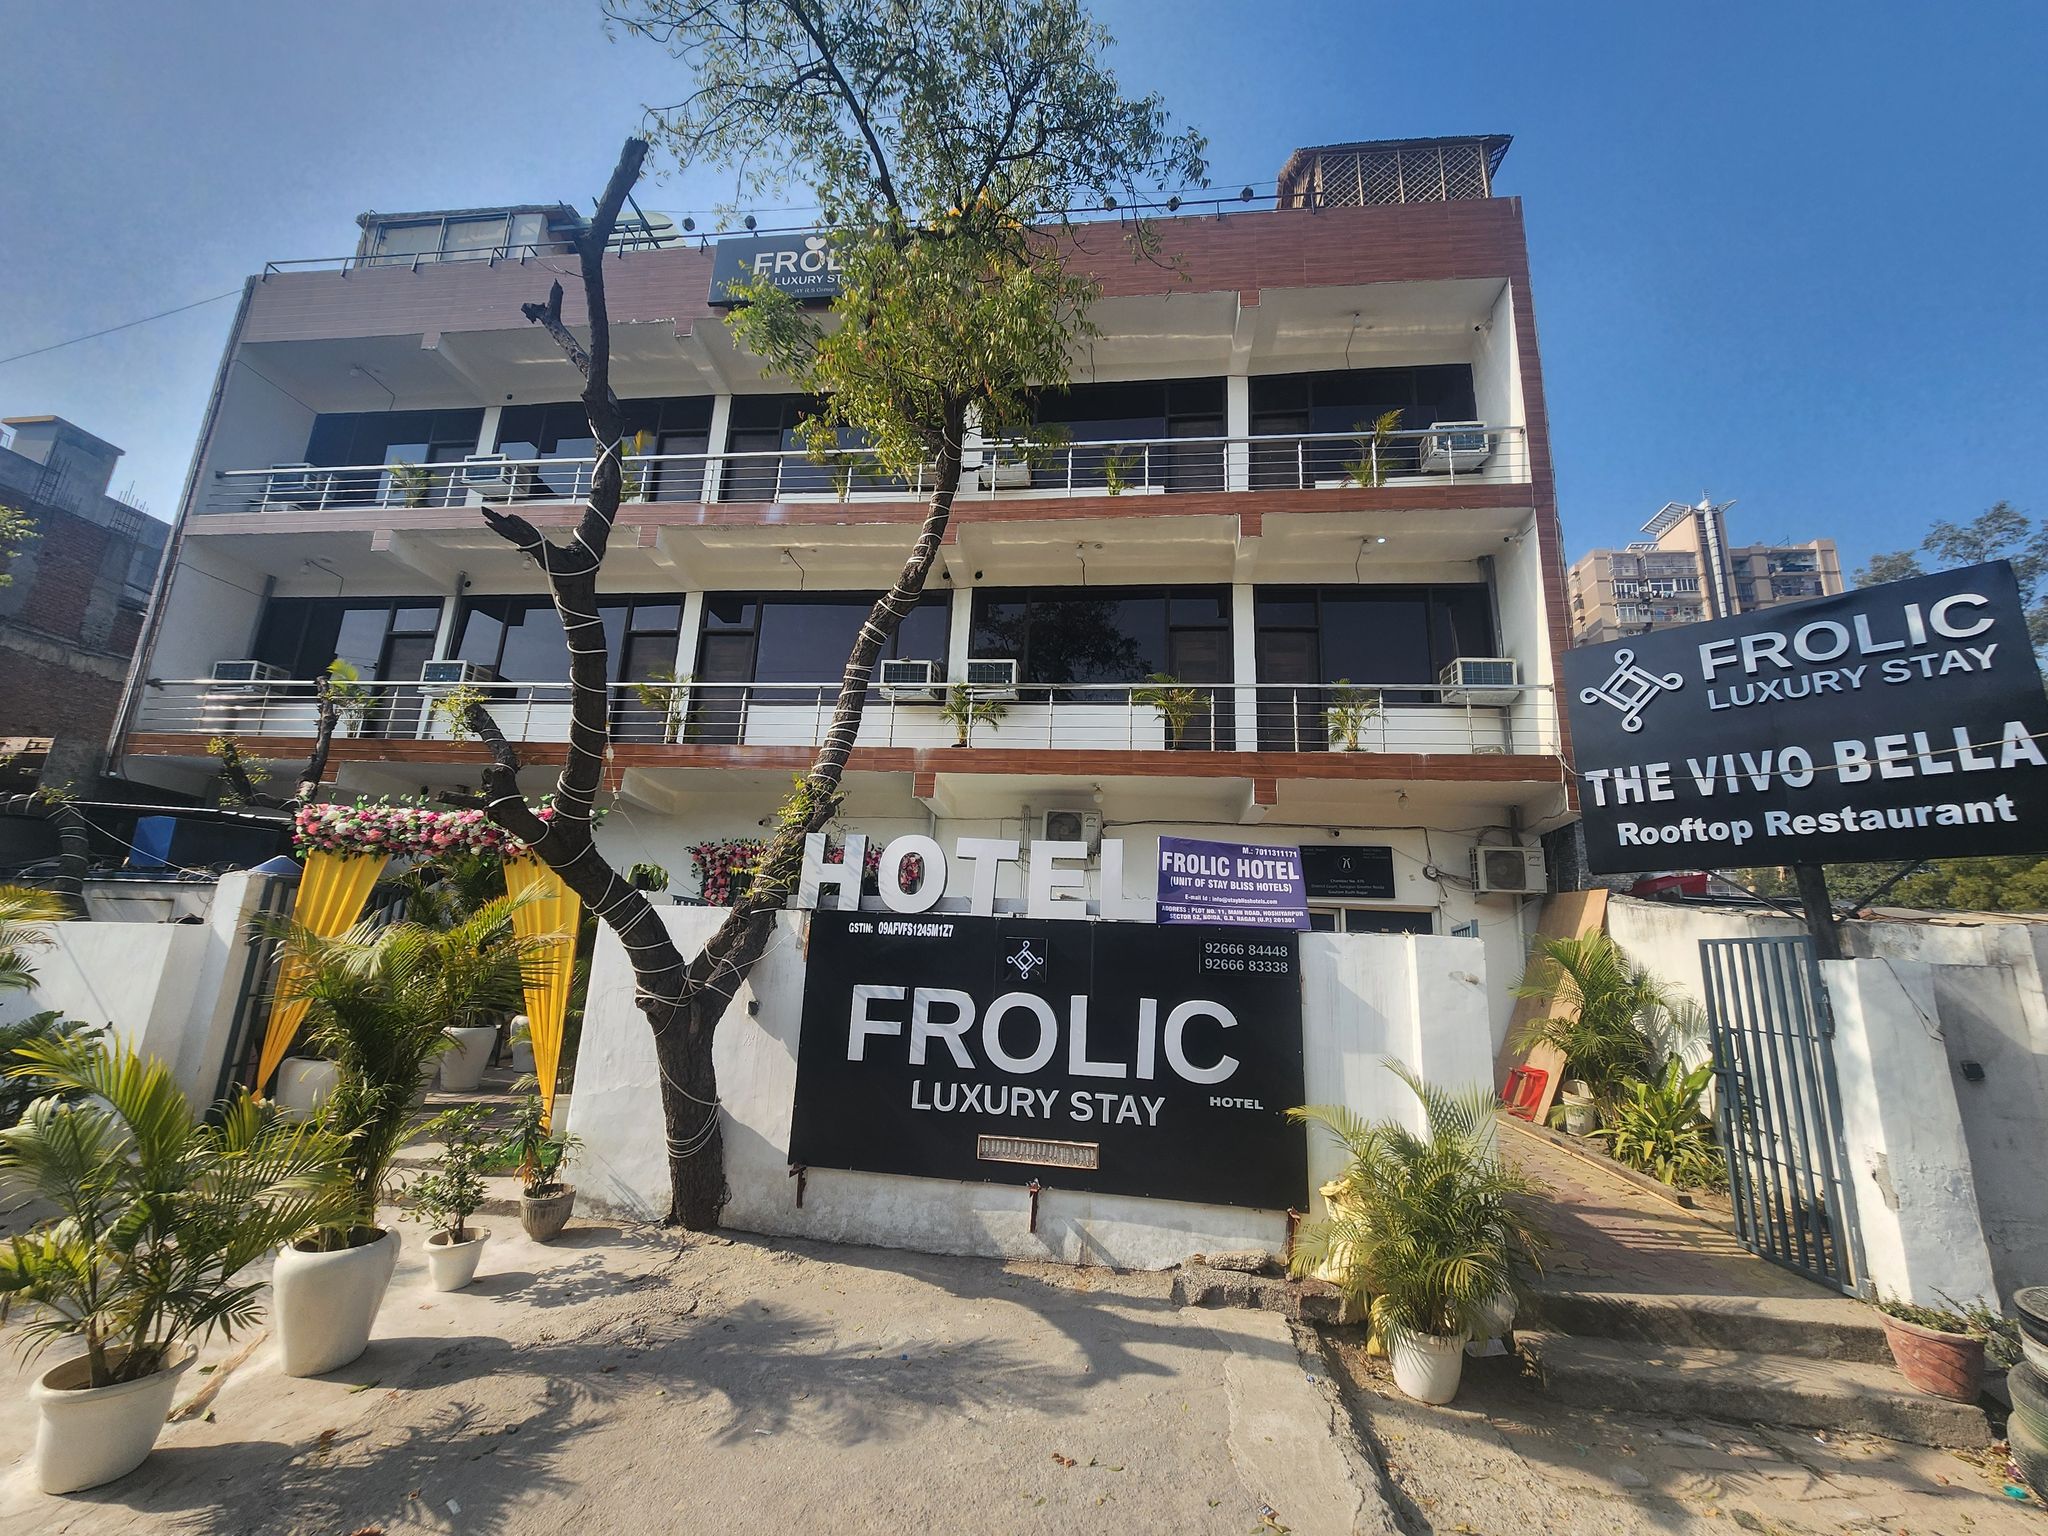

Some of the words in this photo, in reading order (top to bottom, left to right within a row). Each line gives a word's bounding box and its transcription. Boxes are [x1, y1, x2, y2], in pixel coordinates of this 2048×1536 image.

[753, 248, 843, 275] FROL
[774, 275, 824, 286] LUXURY
[1698, 592, 1996, 682] FROLIC
[1706, 664, 1868, 711] LUXURY
[1882, 643, 1999, 685] STAY
[1584, 761, 1675, 807] THE
[1686, 745, 1814, 797] VIVO
[1832, 720, 2047, 784] BELLA
[1617, 816, 1754, 847] Rooftop
[1764, 793, 2019, 837] Restaurant
[1255, 848, 1298, 858] 7011311171
[1162, 851, 1230, 877] FROLIC
[1237, 858, 1300, 880] HOTEL
[796, 832, 1157, 923] HOTEL
[1170, 876, 1193, 887] (UNIT
[1194, 879, 1206, 888] OF
[1208, 880, 1228, 890] STAY
[1230, 881, 1255, 891] BLISS
[1256, 882, 1293, 893] HOTELS)
[1184, 893, 1202, 901] E-mail
[1161, 905, 1187, 913] ADDRESS
[848, 922, 874, 934] GSTIN:
[1204, 942, 1245, 955] 92666
[1248, 944, 1288, 957] 84448
[1204, 958, 1245, 971] 92666
[1248, 960, 1289, 973] 83338
[846, 983, 1241, 1086] FROLIC
[910, 1079, 1060, 1121] LUXURY
[1069, 1090, 1166, 1127] STAY
[1209, 1095, 1265, 1111] HOTEL
